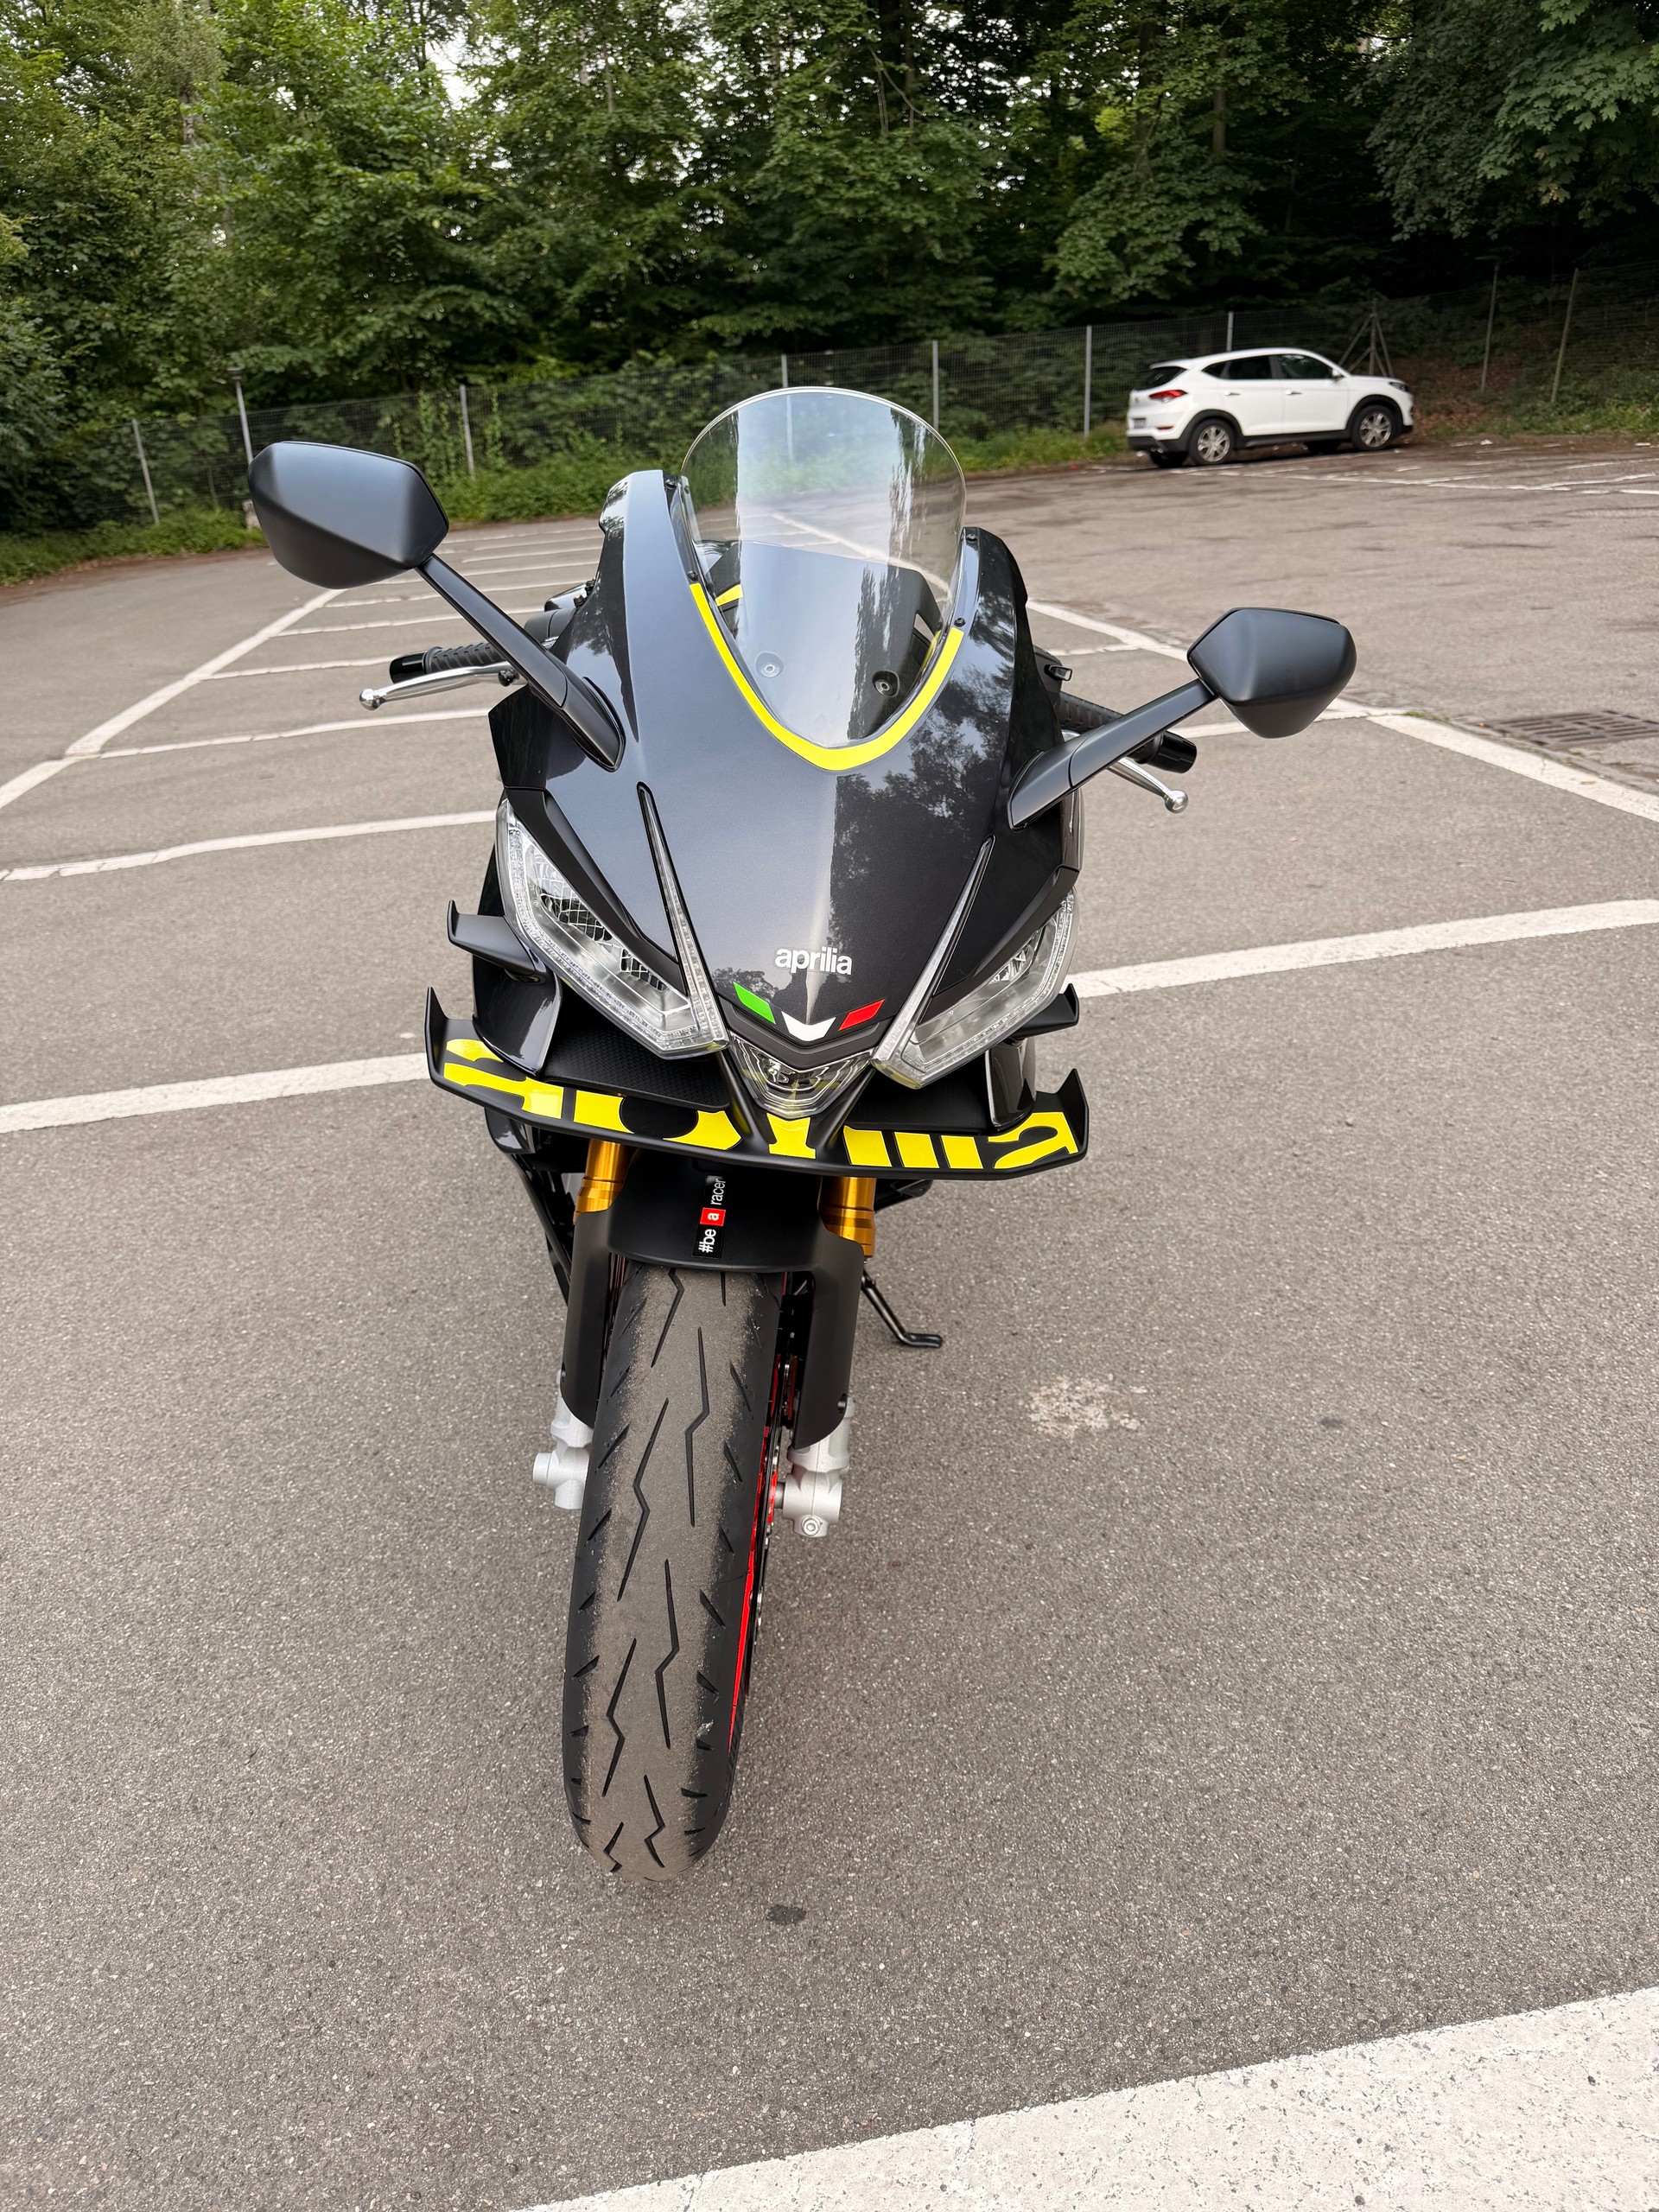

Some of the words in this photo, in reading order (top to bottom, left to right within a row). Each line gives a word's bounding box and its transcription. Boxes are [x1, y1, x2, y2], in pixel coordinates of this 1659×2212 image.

[775, 946, 852, 975] aprilia
[710, 1178, 726, 1205] racer
[707, 1212, 720, 1221] a
[698, 1229, 716, 1253] #be
